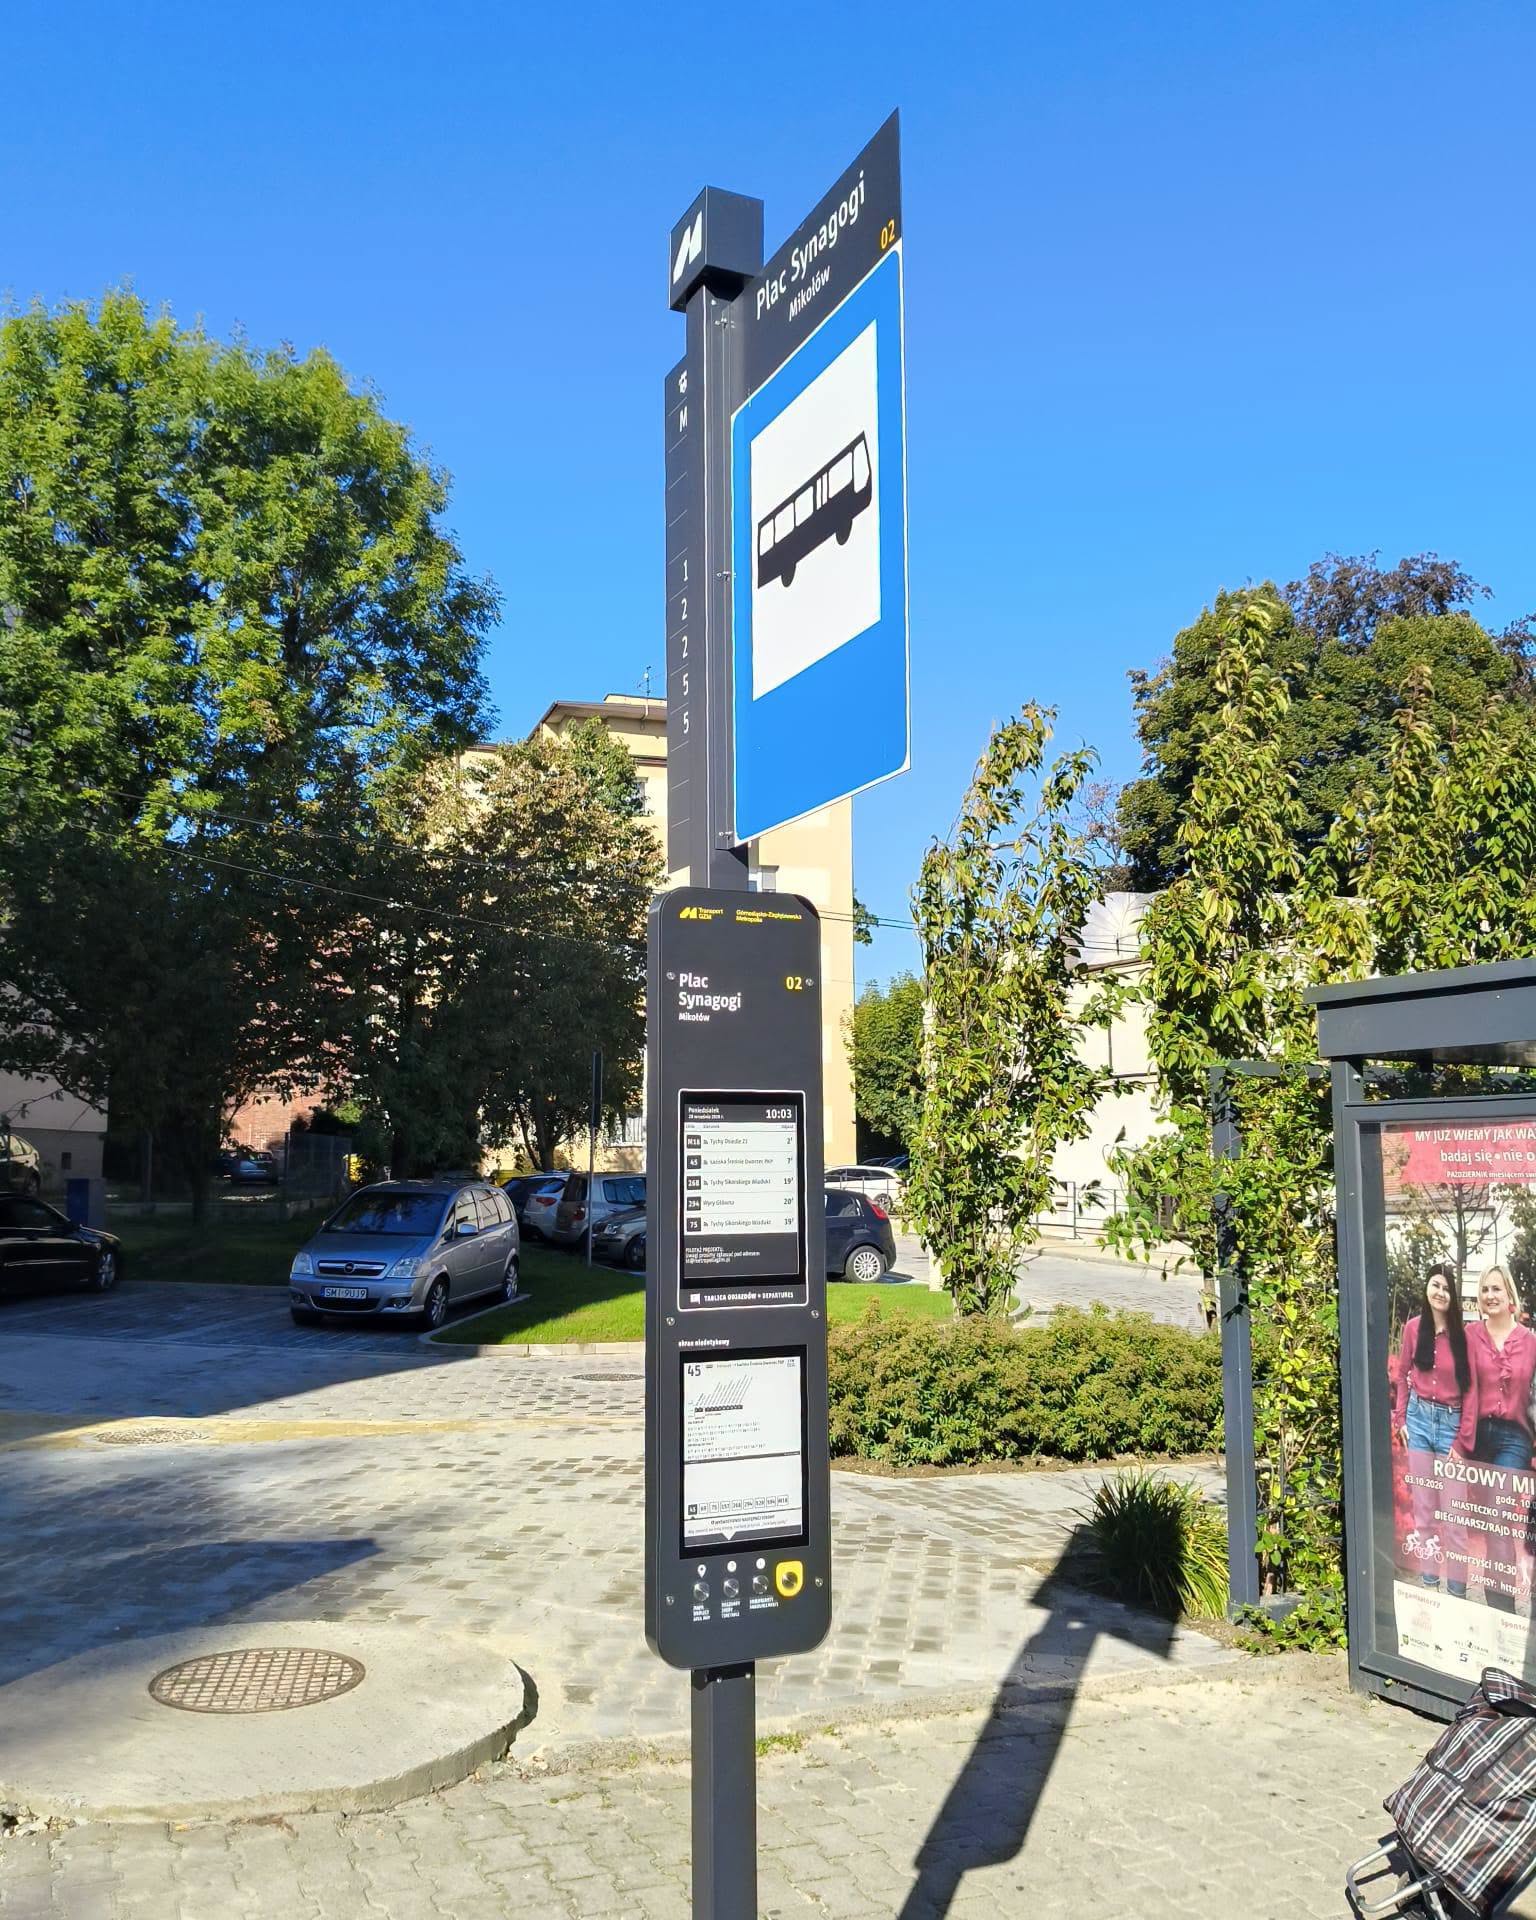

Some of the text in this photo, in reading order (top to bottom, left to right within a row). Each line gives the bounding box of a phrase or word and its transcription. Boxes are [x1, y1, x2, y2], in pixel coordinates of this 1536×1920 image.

[880, 219, 895, 250] 02
[756, 170, 865, 320] Plac Synagogi
[788, 265, 831, 322] Mikołów
[679, 973, 709, 989] Plac
[786, 976, 803, 990] 02
[678, 992, 742, 1011] Synagogi
[678, 1012, 710, 1022] Mikołów
[765, 1109, 793, 1119] 10:03
[1415, 1127, 1536, 1144] MY JUŻ WIEMY JAK WA
[1440, 1149, 1472, 1165] badaj
[1475, 1149, 1493, 1165] się
[1503, 1149, 1523, 1161] nie
[1446, 1170, 1488, 1178] PAŹDZIERNIK
[704, 1291, 794, 1302] TABLICA ODJAZDÓW DEPARTURES
[687, 1365, 701, 1377] 45
[1433, 1456, 1507, 1490] RÓŻOWY
[1451, 1499, 1499, 1517] MIASTECZKO
[1495, 1495, 1518, 1507] godz.
[1434, 1510, 1510, 1536] BIEG/MARSZ/RAJD
[1446, 1551, 1517, 1576] rowerzyści 10:30
[1470, 1573, 1497, 1589] ZAPISY:
